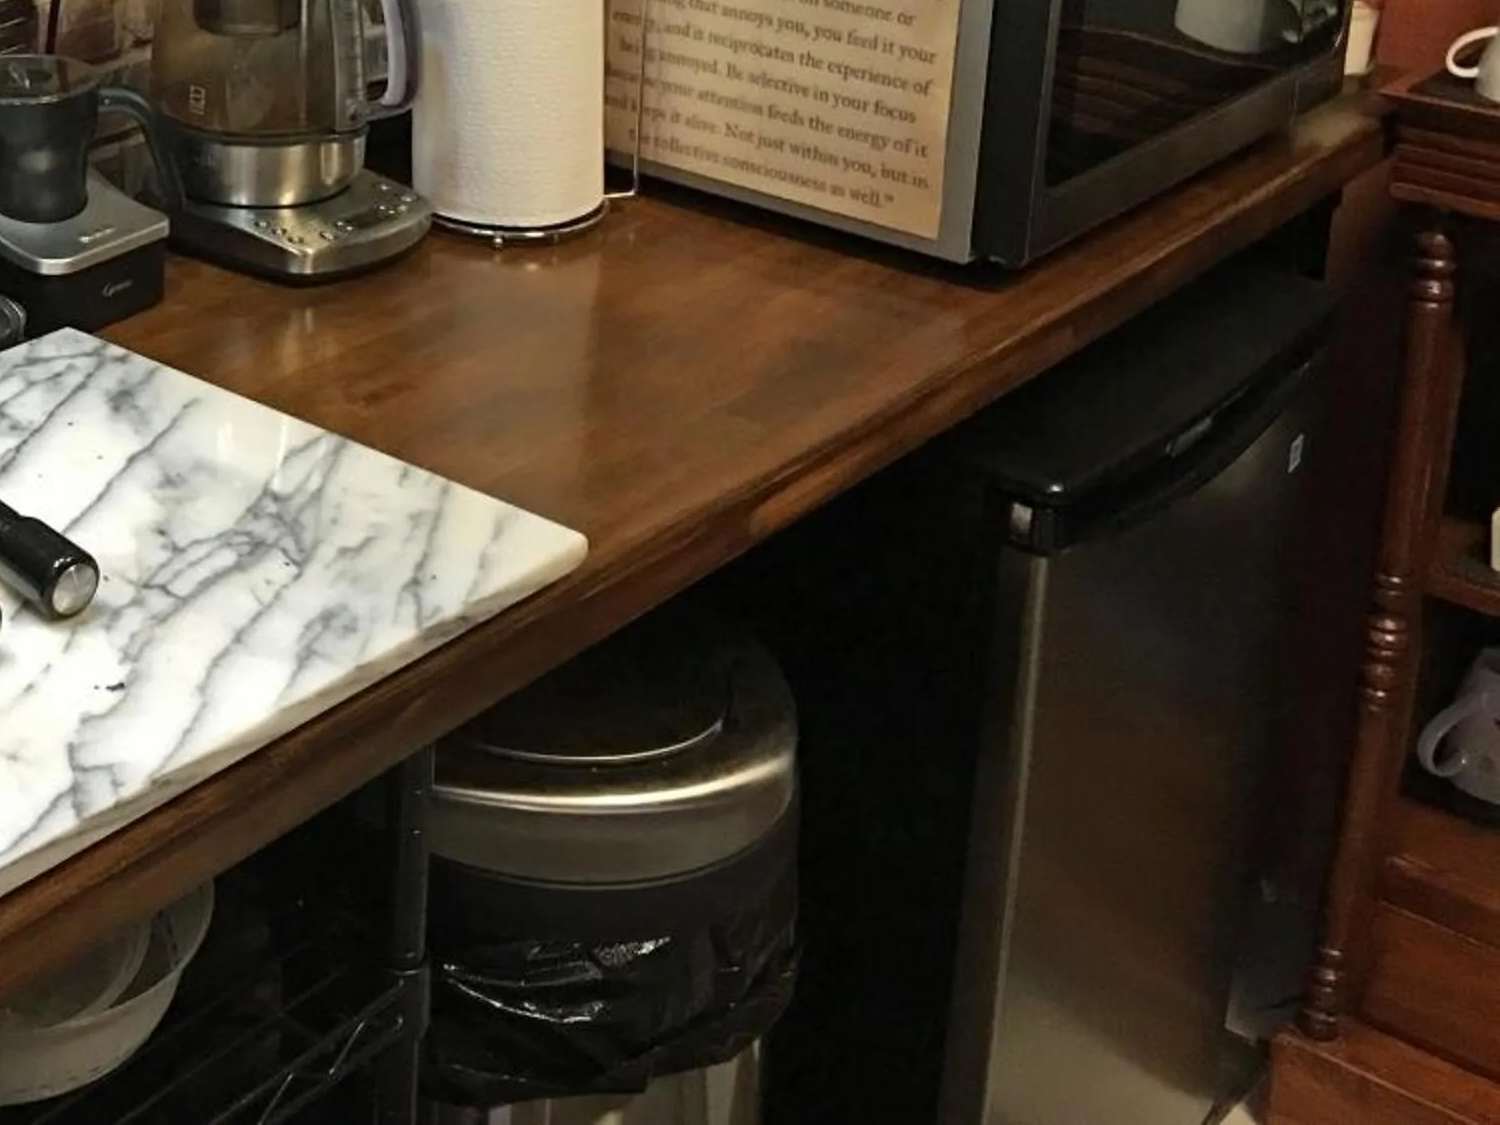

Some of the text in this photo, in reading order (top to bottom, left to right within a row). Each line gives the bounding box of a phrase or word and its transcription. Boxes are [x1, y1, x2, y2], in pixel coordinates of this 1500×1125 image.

[721, 5, 774, 27] annoys
[776, 17, 811, 38] you,
[813, 25, 842, 42] you
[846, 28, 878, 51] feed
[882, 38, 896, 55] it
[898, 44, 938, 64] your
[897, 12, 916, 25] or
[665, 21, 690, 38] and
[708, 32, 794, 63] reciprocates
[799, 51, 823, 69] the
[827, 60, 908, 89] experience
[913, 79, 933, 97] of
[660, 80, 694, 97] your
[698, 90, 763, 115] attention
[767, 105, 805, 126] feeds
[809, 115, 833, 134] the
[838, 126, 890, 151] energy
[893, 138, 914, 154] of
[915, 141, 929, 158] it
[748, 71, 810, 97] selective
[813, 86, 829, 102] in
[833, 94, 869, 113] your
[873, 100, 916, 123] focus
[723, 155, 827, 192] consciousness
[830, 184, 845, 197] as
[724, 123, 755, 143] Not
[756, 134, 785, 151] just
[789, 142, 839, 165] within
[843, 155, 877, 178] you,
[881, 162, 907, 182] but
[911, 175, 929, 189] in
